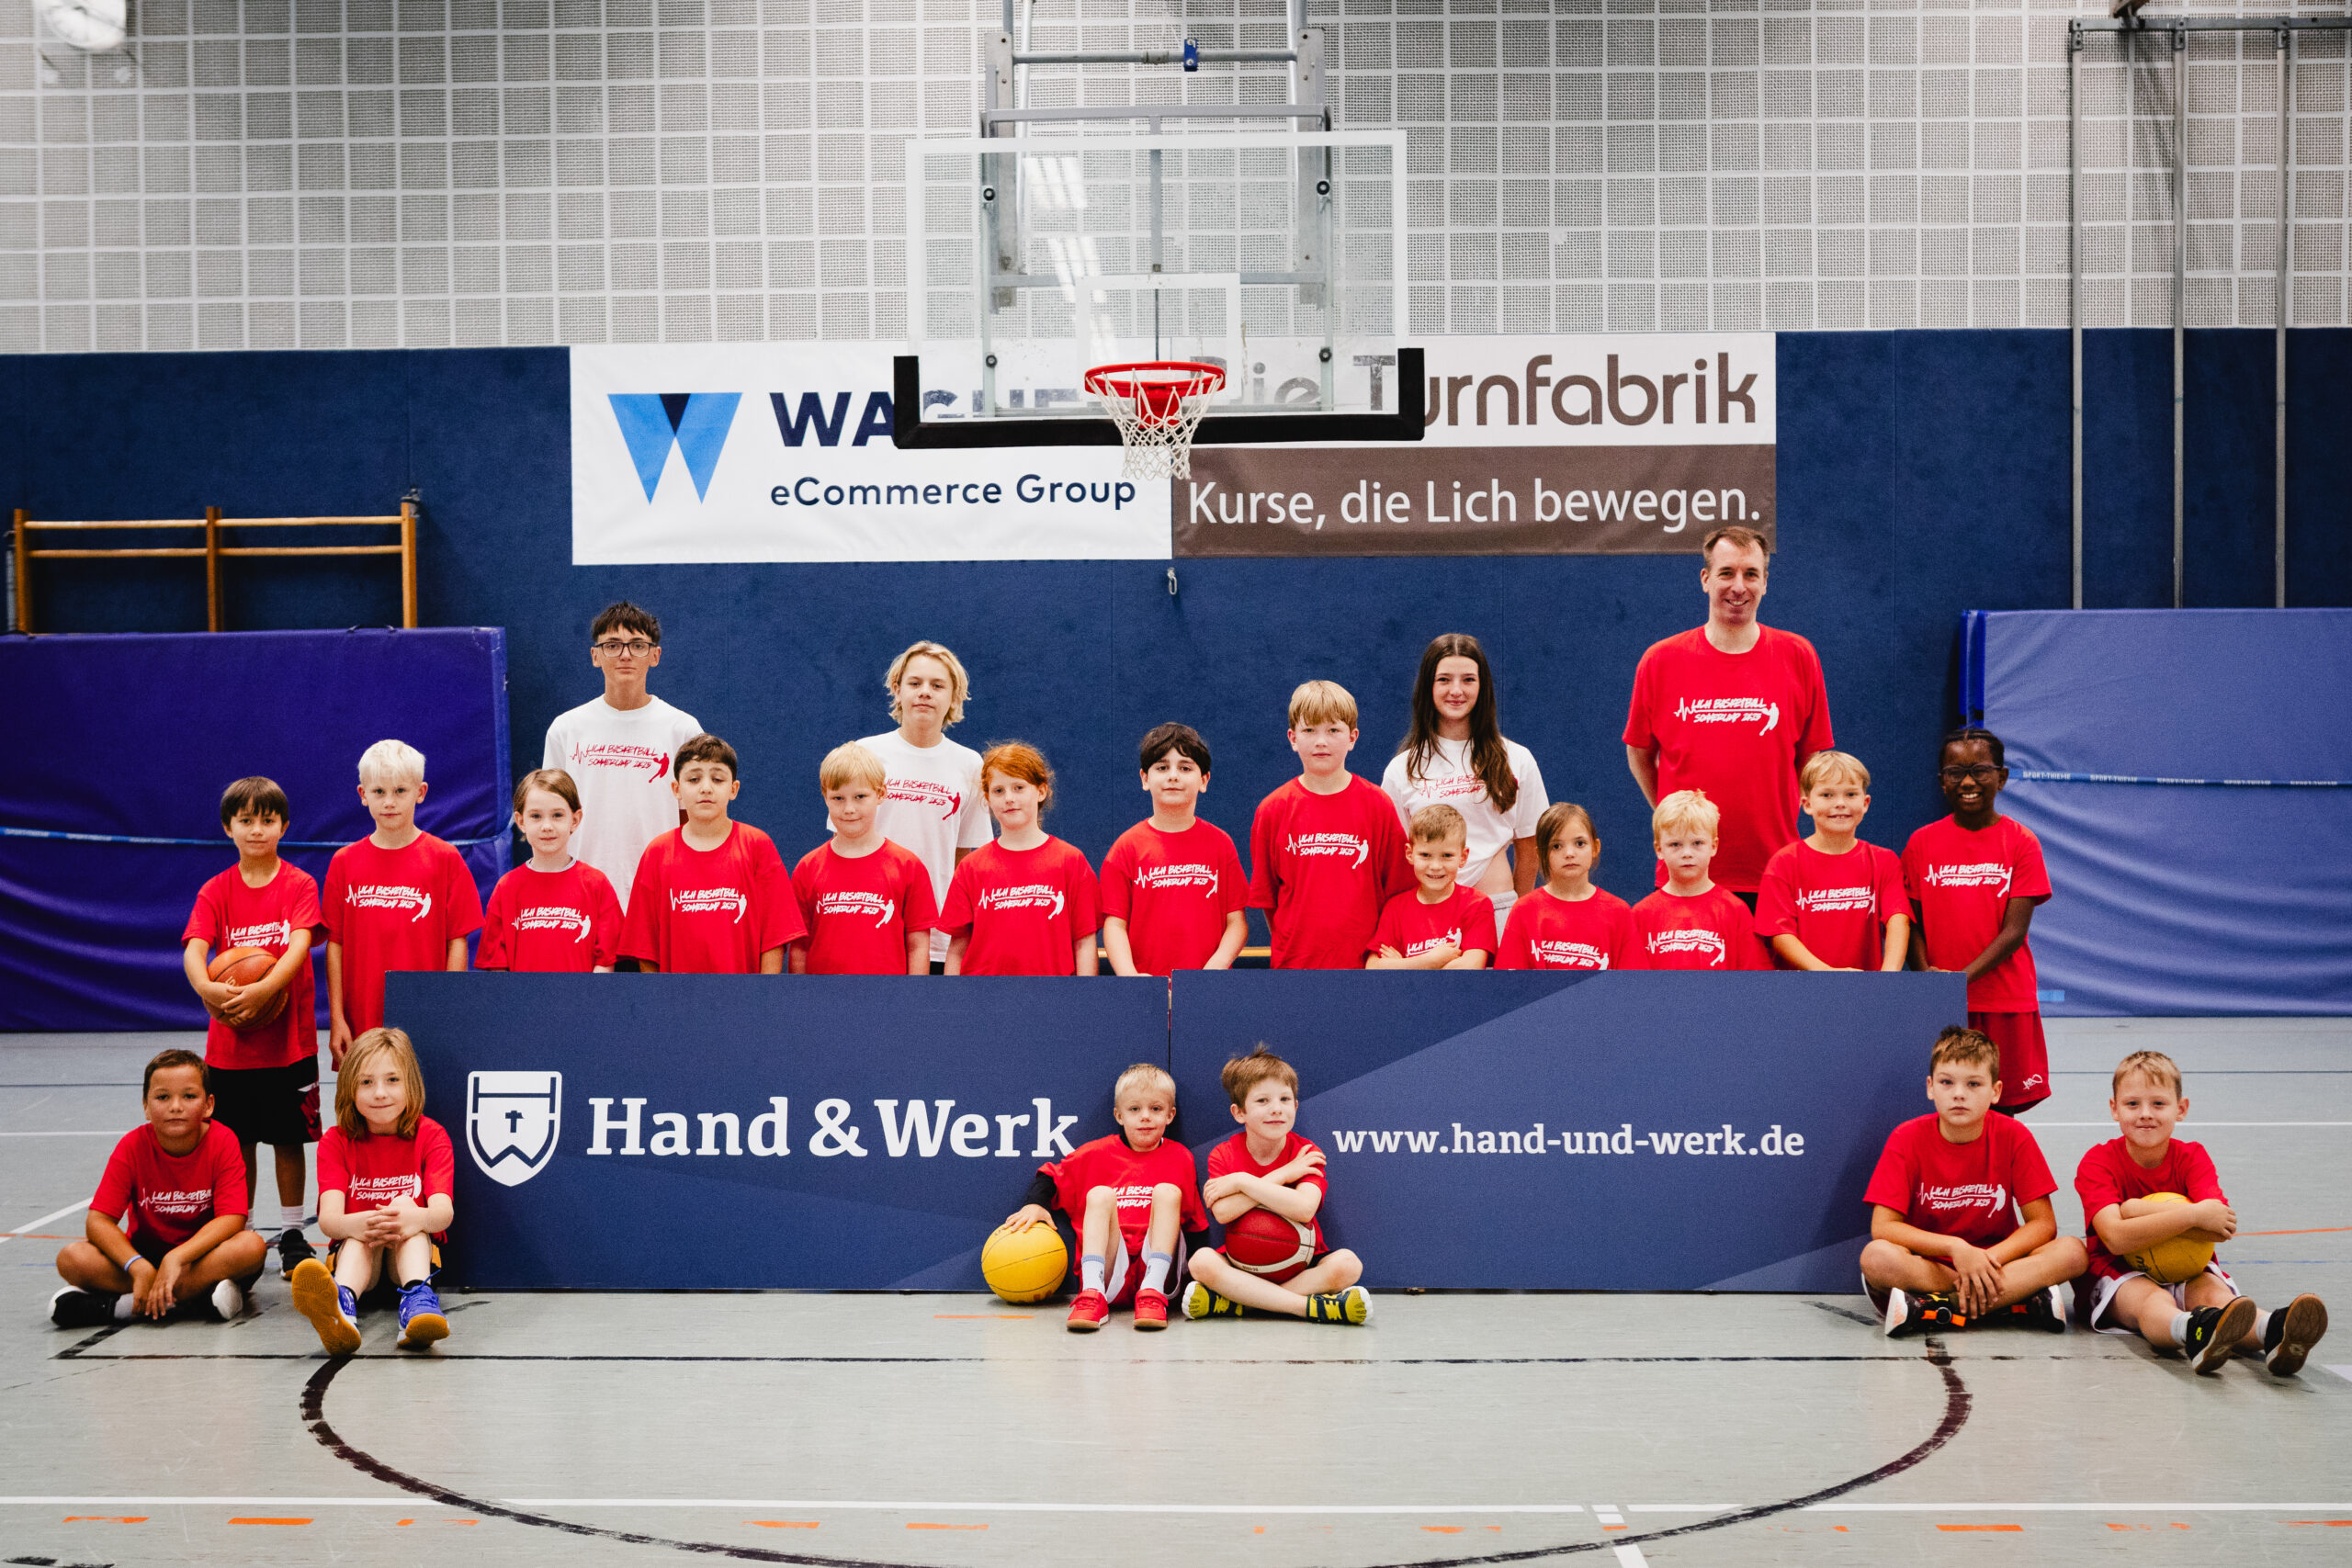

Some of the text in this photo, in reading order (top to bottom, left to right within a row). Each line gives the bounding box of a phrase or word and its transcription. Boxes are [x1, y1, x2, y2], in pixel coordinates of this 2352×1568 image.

[770, 473, 1136, 511] eCommerce Group
[1188, 478, 1761, 533] Kurse, die Lich bewegen.
[1690, 697, 1767, 709] LICH BASKETBALL
[586, 743, 658, 757] LICH BASKETBALL
[902, 779, 952, 795] BASKETBALL
[586, 1096, 1080, 1158] Hand & Werk
[1331, 1122, 1805, 1156] www.hand-und-werk.de
